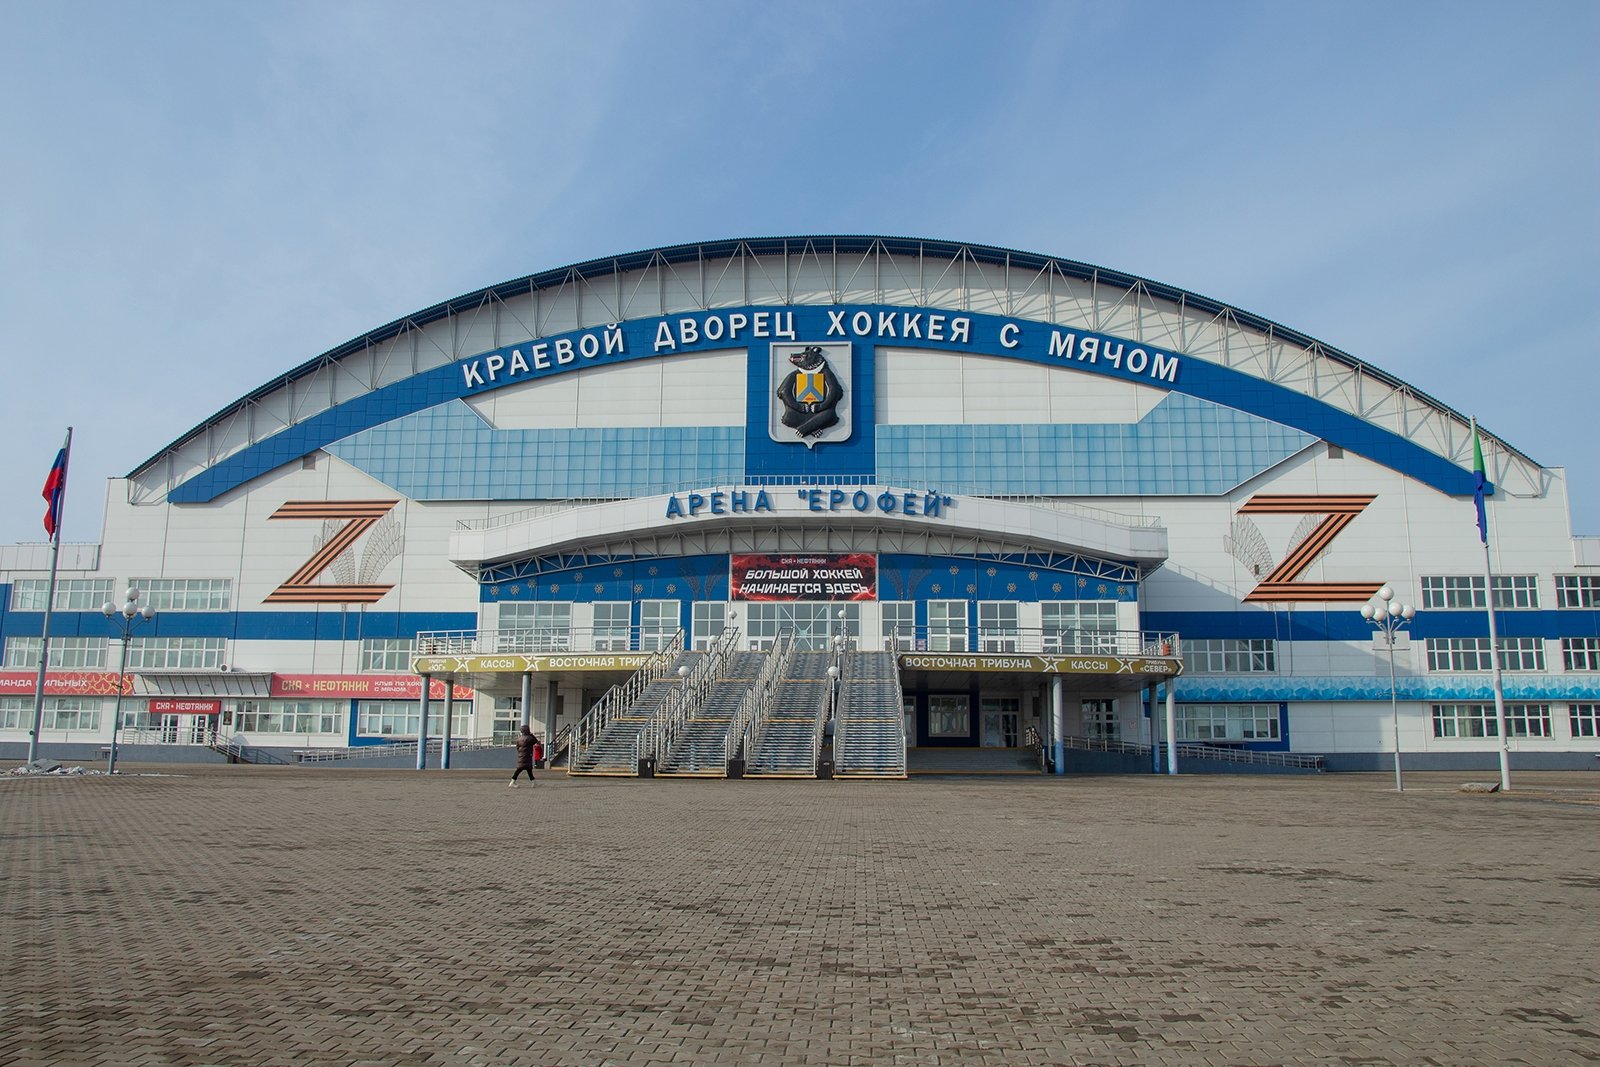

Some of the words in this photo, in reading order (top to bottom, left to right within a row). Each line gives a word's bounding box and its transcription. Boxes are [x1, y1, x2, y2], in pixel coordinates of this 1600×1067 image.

[463, 323, 624, 388] КРАЕВОЙ
[654, 312, 796, 352] ДВОРЕЦ
[826, 311, 970, 343] ХОККЕЯ
[1000, 323, 1019, 349] С
[1049, 331, 1179, 383] МЯЧОМ
[665, 490, 771, 518] АРЕНА
[745, 568, 809, 580] БОЛЬШОЙ
[813, 567, 864, 579] ХОККЕЙ
[739, 583, 822, 594] НАЧИНАЕТСЯ
[825, 583, 869, 595] ЗДЕСЬ
[480, 659, 515, 669] КАССЫ
[549, 657, 615, 668] ВОСТОЧНАЯ
[905, 657, 977, 668] ВОСТОЧНАЯ
[981, 658, 1032, 668] ТРИБУНА
[1071, 660, 1109, 670] КАССЫ
[1140, 664, 1173, 673] «СЕВЕР»
[281, 680, 302, 691] СКА
[313, 680, 369, 692] НЕФТЯНИК
[156, 702, 170, 710] СКА
[176, 702, 214, 711] НЕФТЯНИК
